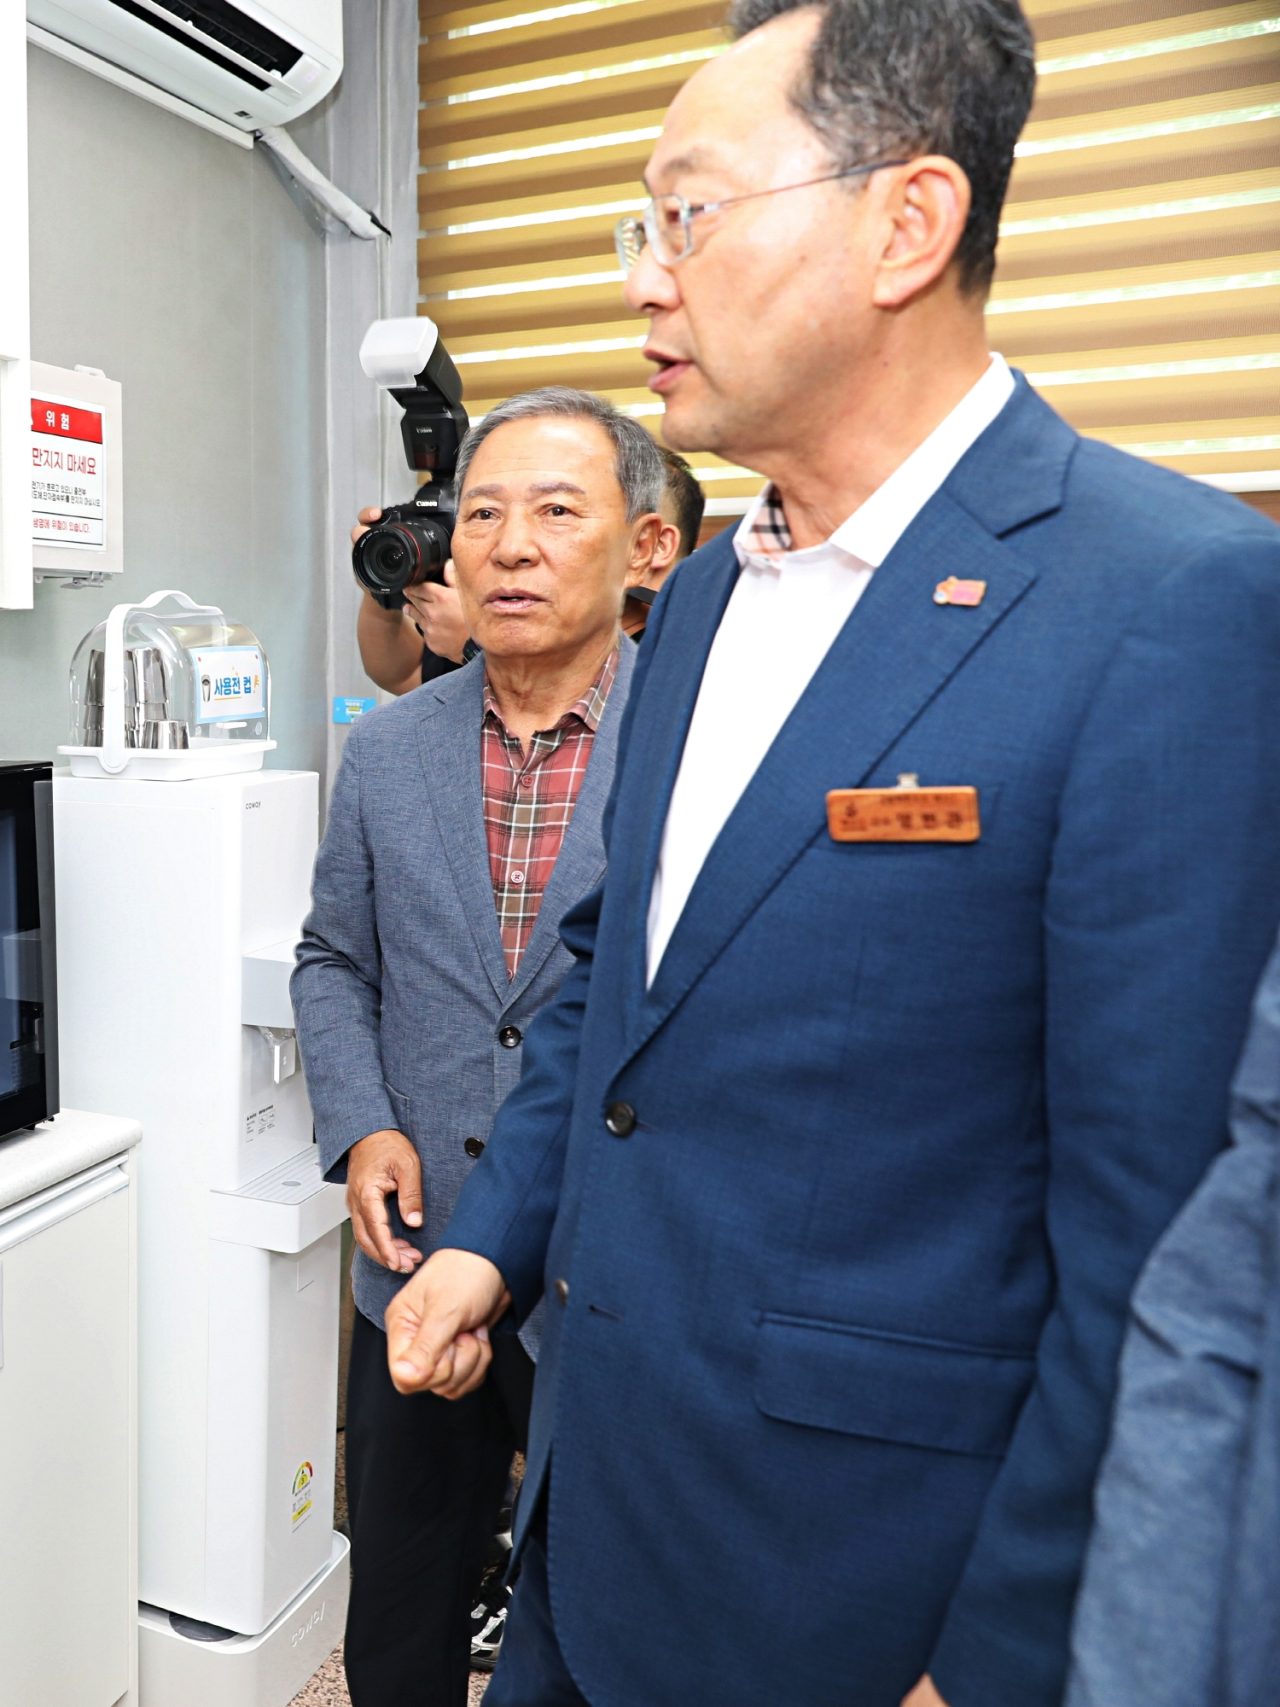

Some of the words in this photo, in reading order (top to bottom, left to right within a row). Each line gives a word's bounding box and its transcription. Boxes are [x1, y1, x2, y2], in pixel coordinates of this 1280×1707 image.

[32, 447, 64, 470] 만지지
[67, 454, 96, 475] 마세요
[214, 676, 241, 696] 사용전
[243, 676, 251, 694] 컵
